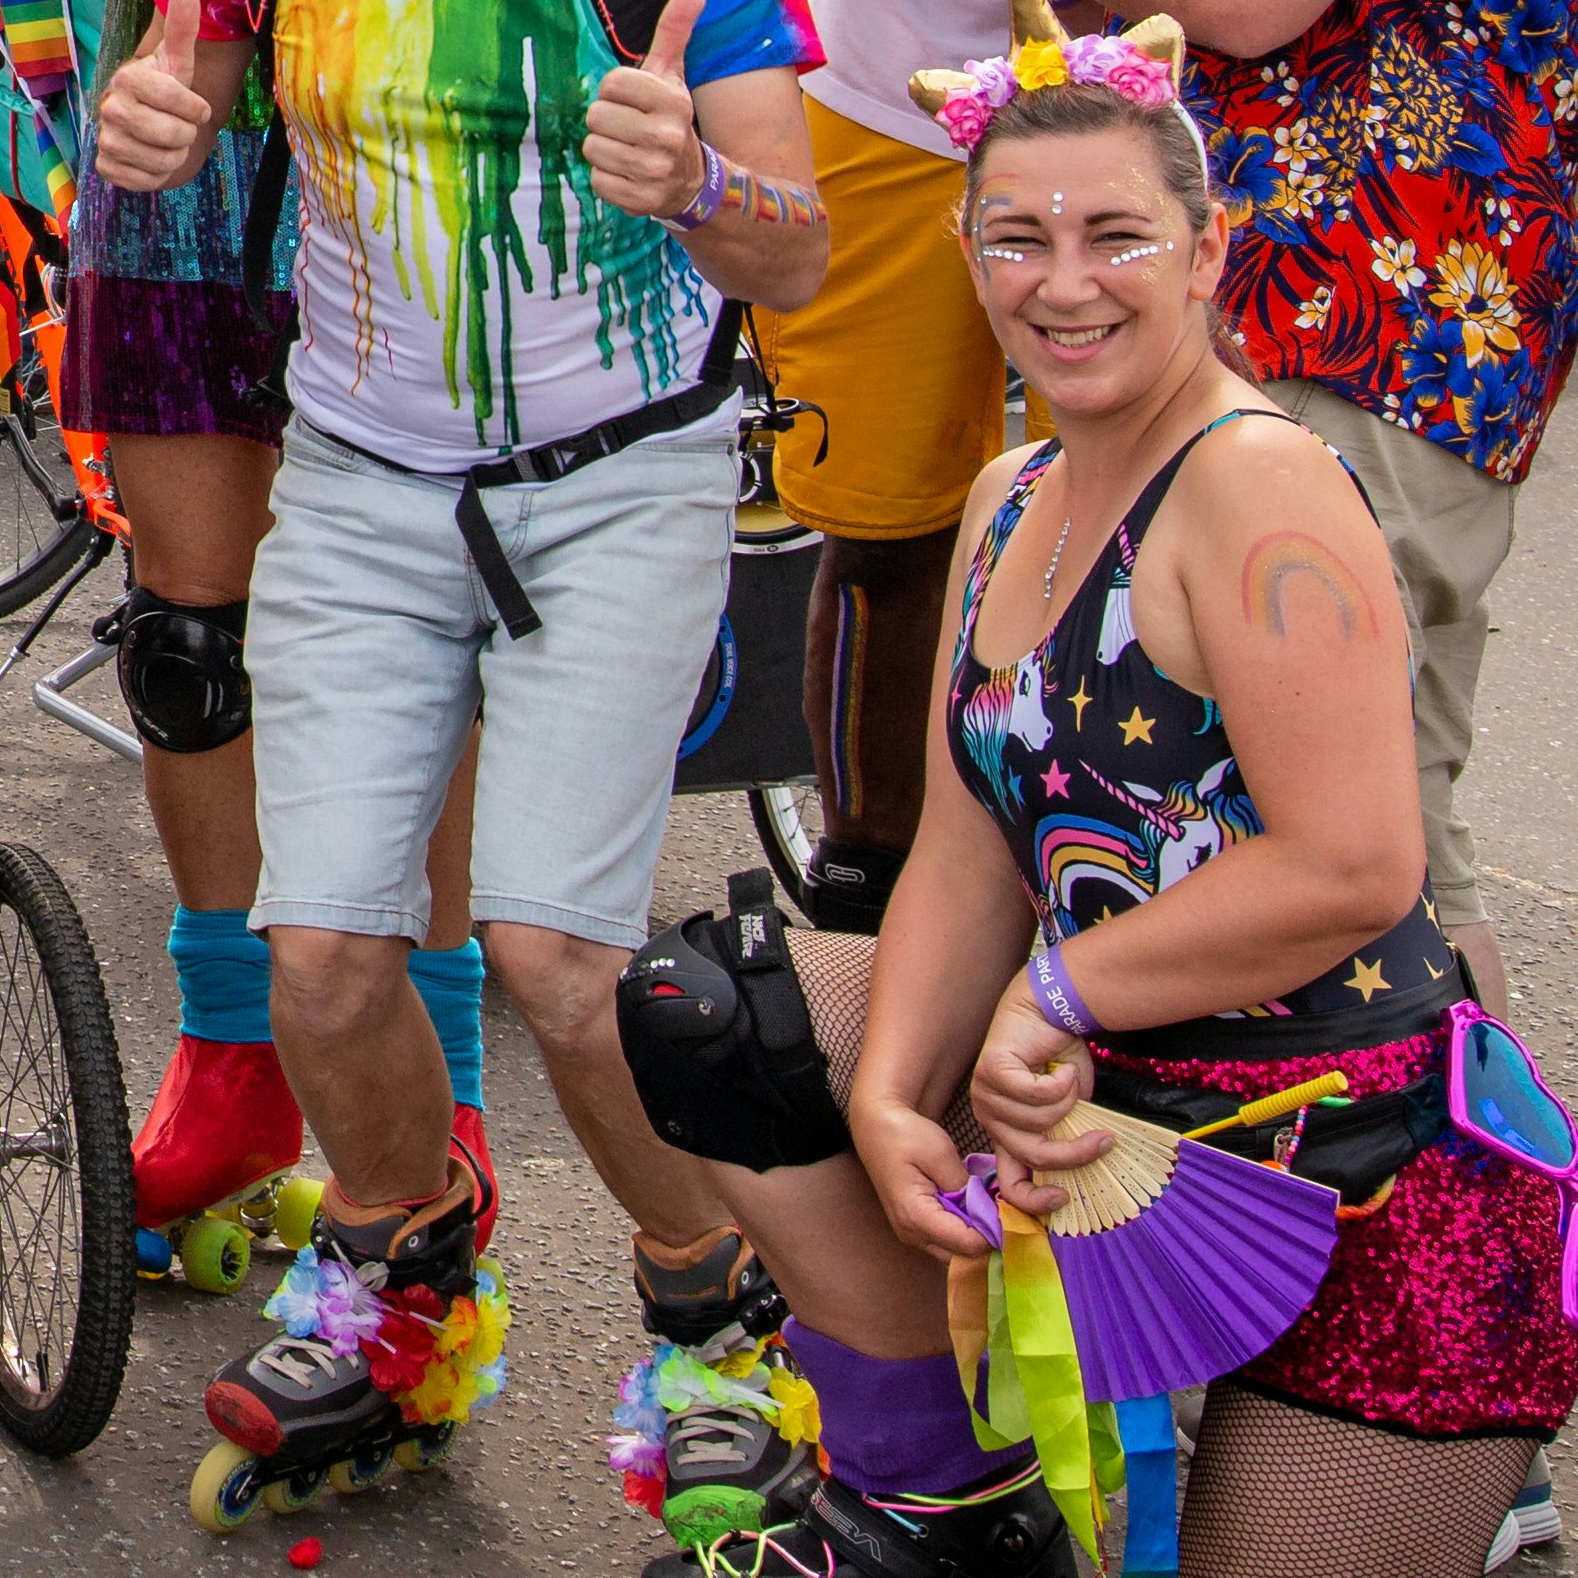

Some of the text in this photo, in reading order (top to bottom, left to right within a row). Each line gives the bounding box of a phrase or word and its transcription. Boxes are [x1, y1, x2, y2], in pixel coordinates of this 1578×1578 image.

[738, 913, 754, 959] FEAR
[751, 914, 766, 942] NO
[1046, 986, 1090, 1034] PARADE
